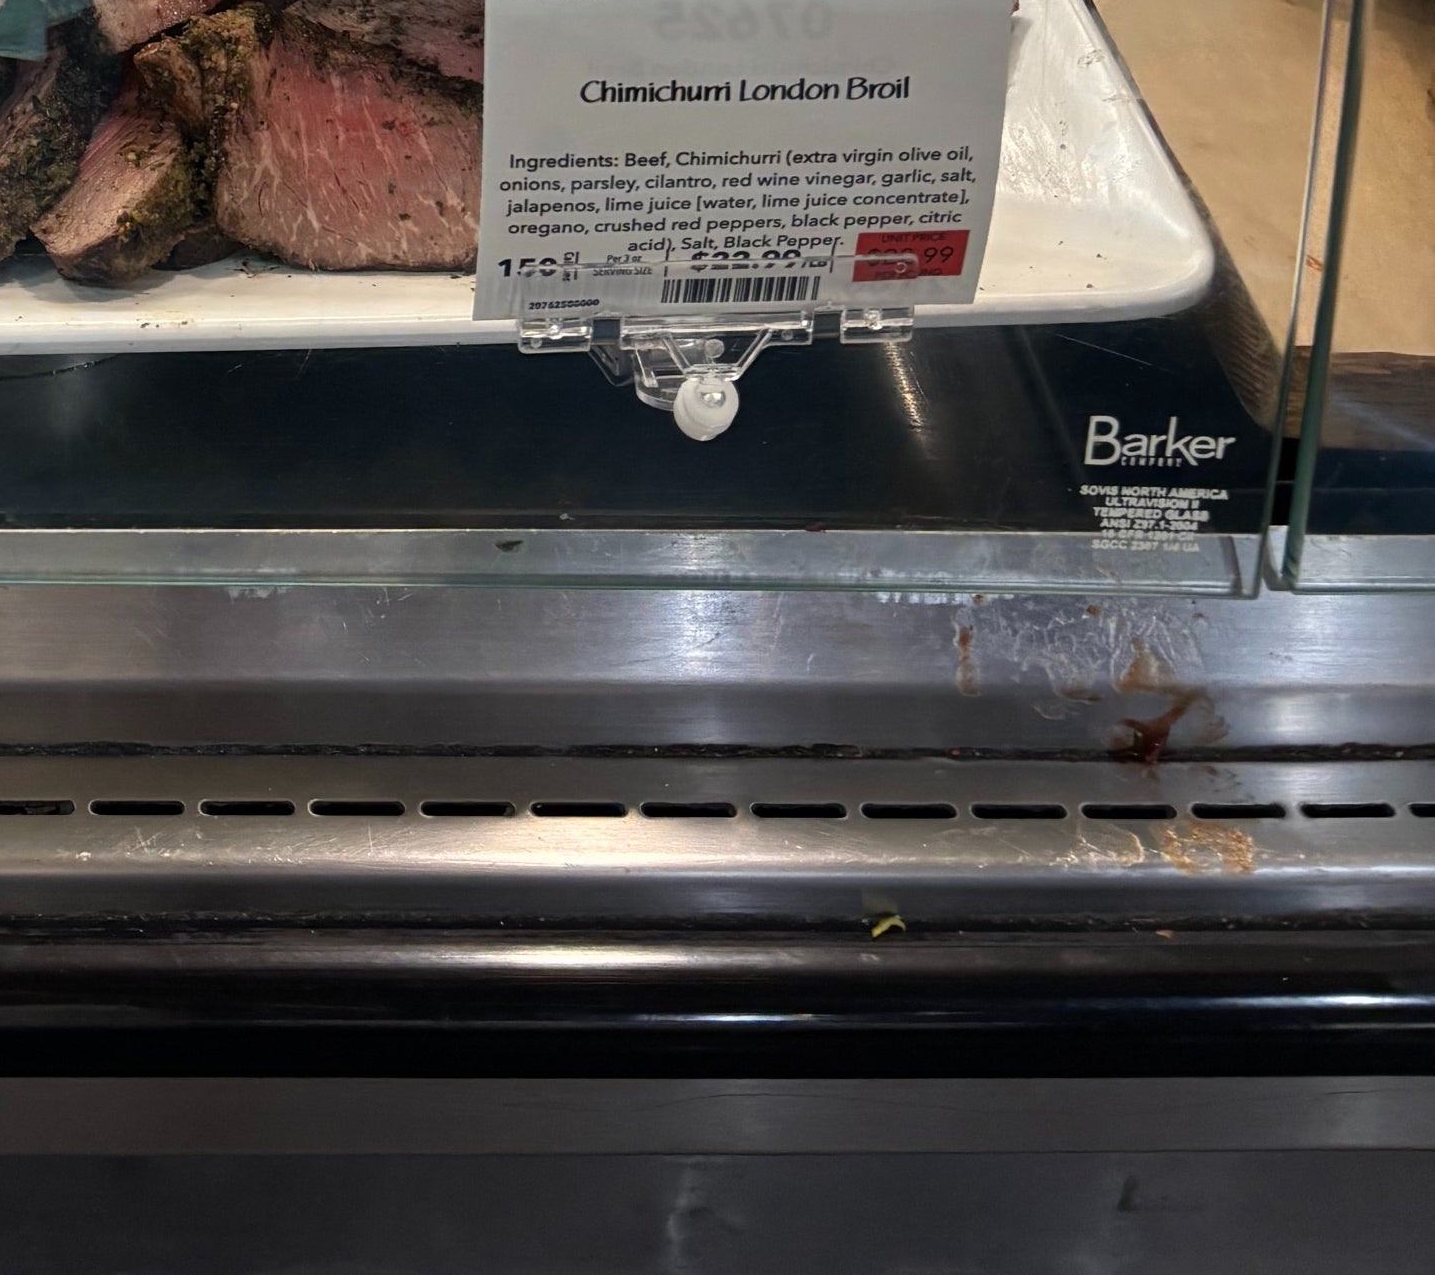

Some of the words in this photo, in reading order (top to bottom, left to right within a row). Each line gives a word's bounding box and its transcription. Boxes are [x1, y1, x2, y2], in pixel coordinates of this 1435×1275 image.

[579, 79, 731, 104] Chimichurri
[738, 78, 840, 102] London
[846, 76, 910, 99] Broil
[509, 153, 619, 172] Ingredients:
[624, 152, 671, 168] Beef,
[675, 150, 781, 167] Chimichurri
[785, 150, 837, 166] (extra
[842, 148, 893, 166] virgin
[898, 147, 941, 162] olive
[946, 146, 974, 162] oil,
[499, 177, 566, 193] onions,
[570, 174, 641, 194] parsley,
[644, 174, 717, 190] cilantro,
[721, 173, 752, 188] red
[757, 172, 800, 187] wine
[804, 171, 877, 189] vinegar,
[881, 168, 936, 187] garlic,
[940, 167, 977, 184] salt,
[505, 199, 601, 217] jalapenos,
[604, 197, 644, 212] lime
[647, 196, 692, 215] juice
[696, 195, 757, 213] [water,
[761, 194, 800, 209] lime
[803, 193, 848, 211] juice
[852, 188, 970, 206] concentrate],
[508, 222, 590, 238] oregano,
[594, 218, 666, 233] crushed
[670, 216, 701, 231] red
[706, 216, 787, 234] peppers,
[791, 213, 839, 228] black
[843, 213, 915, 229] pepper,
[918, 210, 963, 224] citric
[627, 237, 676, 253] acid),
[680, 236, 719, 251] Salt,
[723, 234, 772, 248] Black
[776, 234, 845, 250] Pepper.
[1083, 414, 1237, 467] Barker
[1079, 484, 1119, 496] SOVIS
[1121, 485, 1166, 497] NORTH
[1168, 487, 1229, 500] AMERICA
[1092, 506, 1162, 519] TEMPERED
